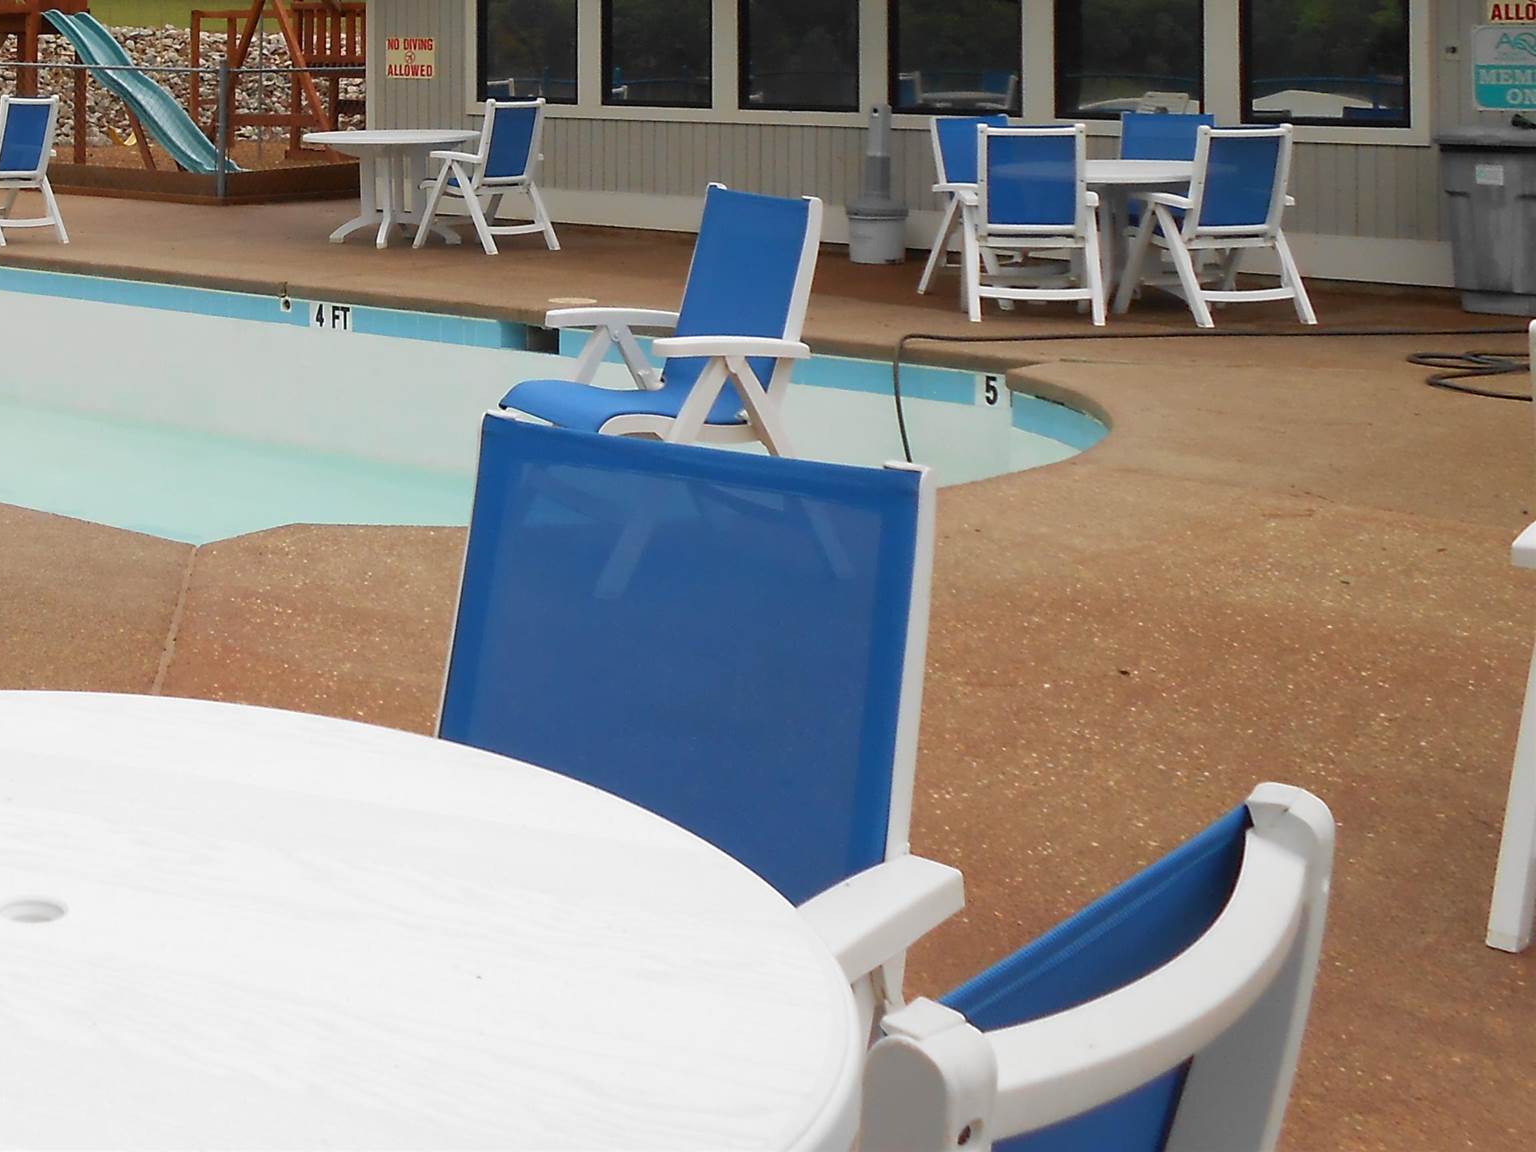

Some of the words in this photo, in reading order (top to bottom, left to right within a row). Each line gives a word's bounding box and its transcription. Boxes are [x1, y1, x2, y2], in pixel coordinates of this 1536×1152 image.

[387, 38, 400, 51] NO
[403, 38, 433, 51] DIVING
[387, 64, 433, 77] ALLOWED
[1479, 69, 1536, 85] MEM
[316, 303, 324, 327] 4
[332, 305, 350, 330] FT
[985, 375, 998, 406] 5
